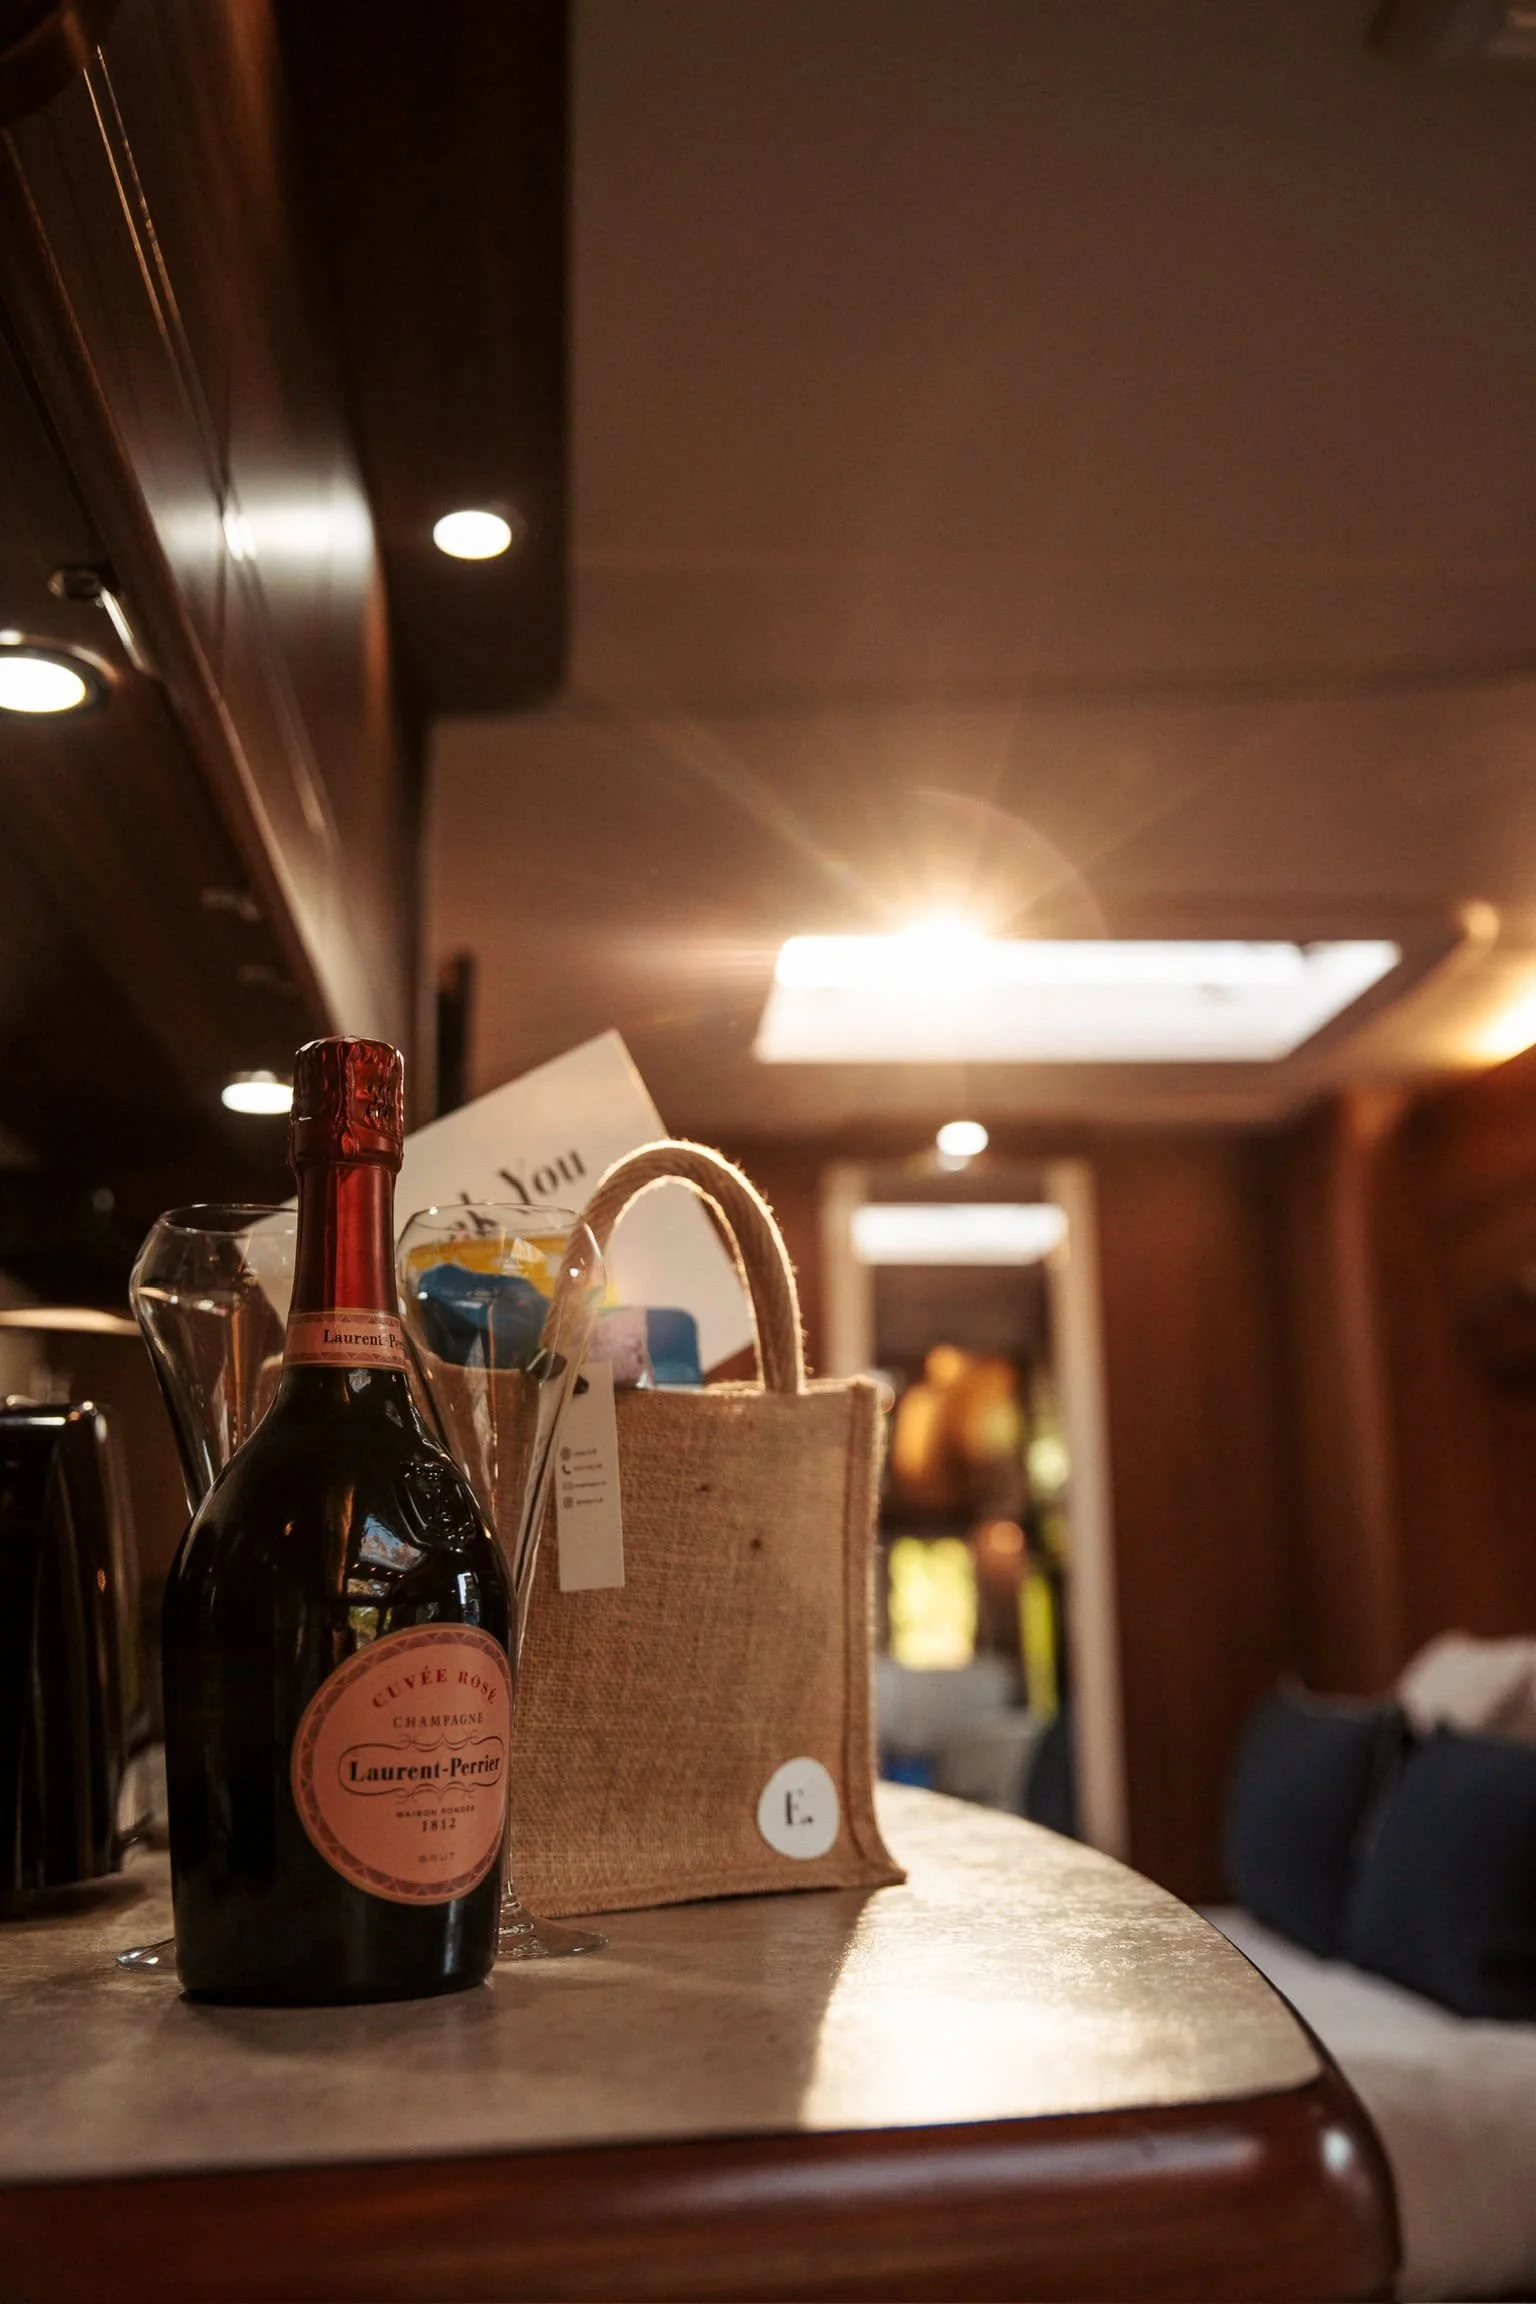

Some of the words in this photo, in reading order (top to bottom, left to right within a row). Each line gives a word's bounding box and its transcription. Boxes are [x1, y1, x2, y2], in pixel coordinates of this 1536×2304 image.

[499, 1150, 586, 1208] You
[372, 1665, 448, 1708] CUVÉE
[458, 1671, 497, 1705] ROSÉ
[393, 1712, 483, 1728] CHAMPAGNE
[350, 1754, 500, 1781] Laurent-Perrier
[421, 1818, 456, 1832] 1812
[418, 1852, 455, 1863] BRUT
